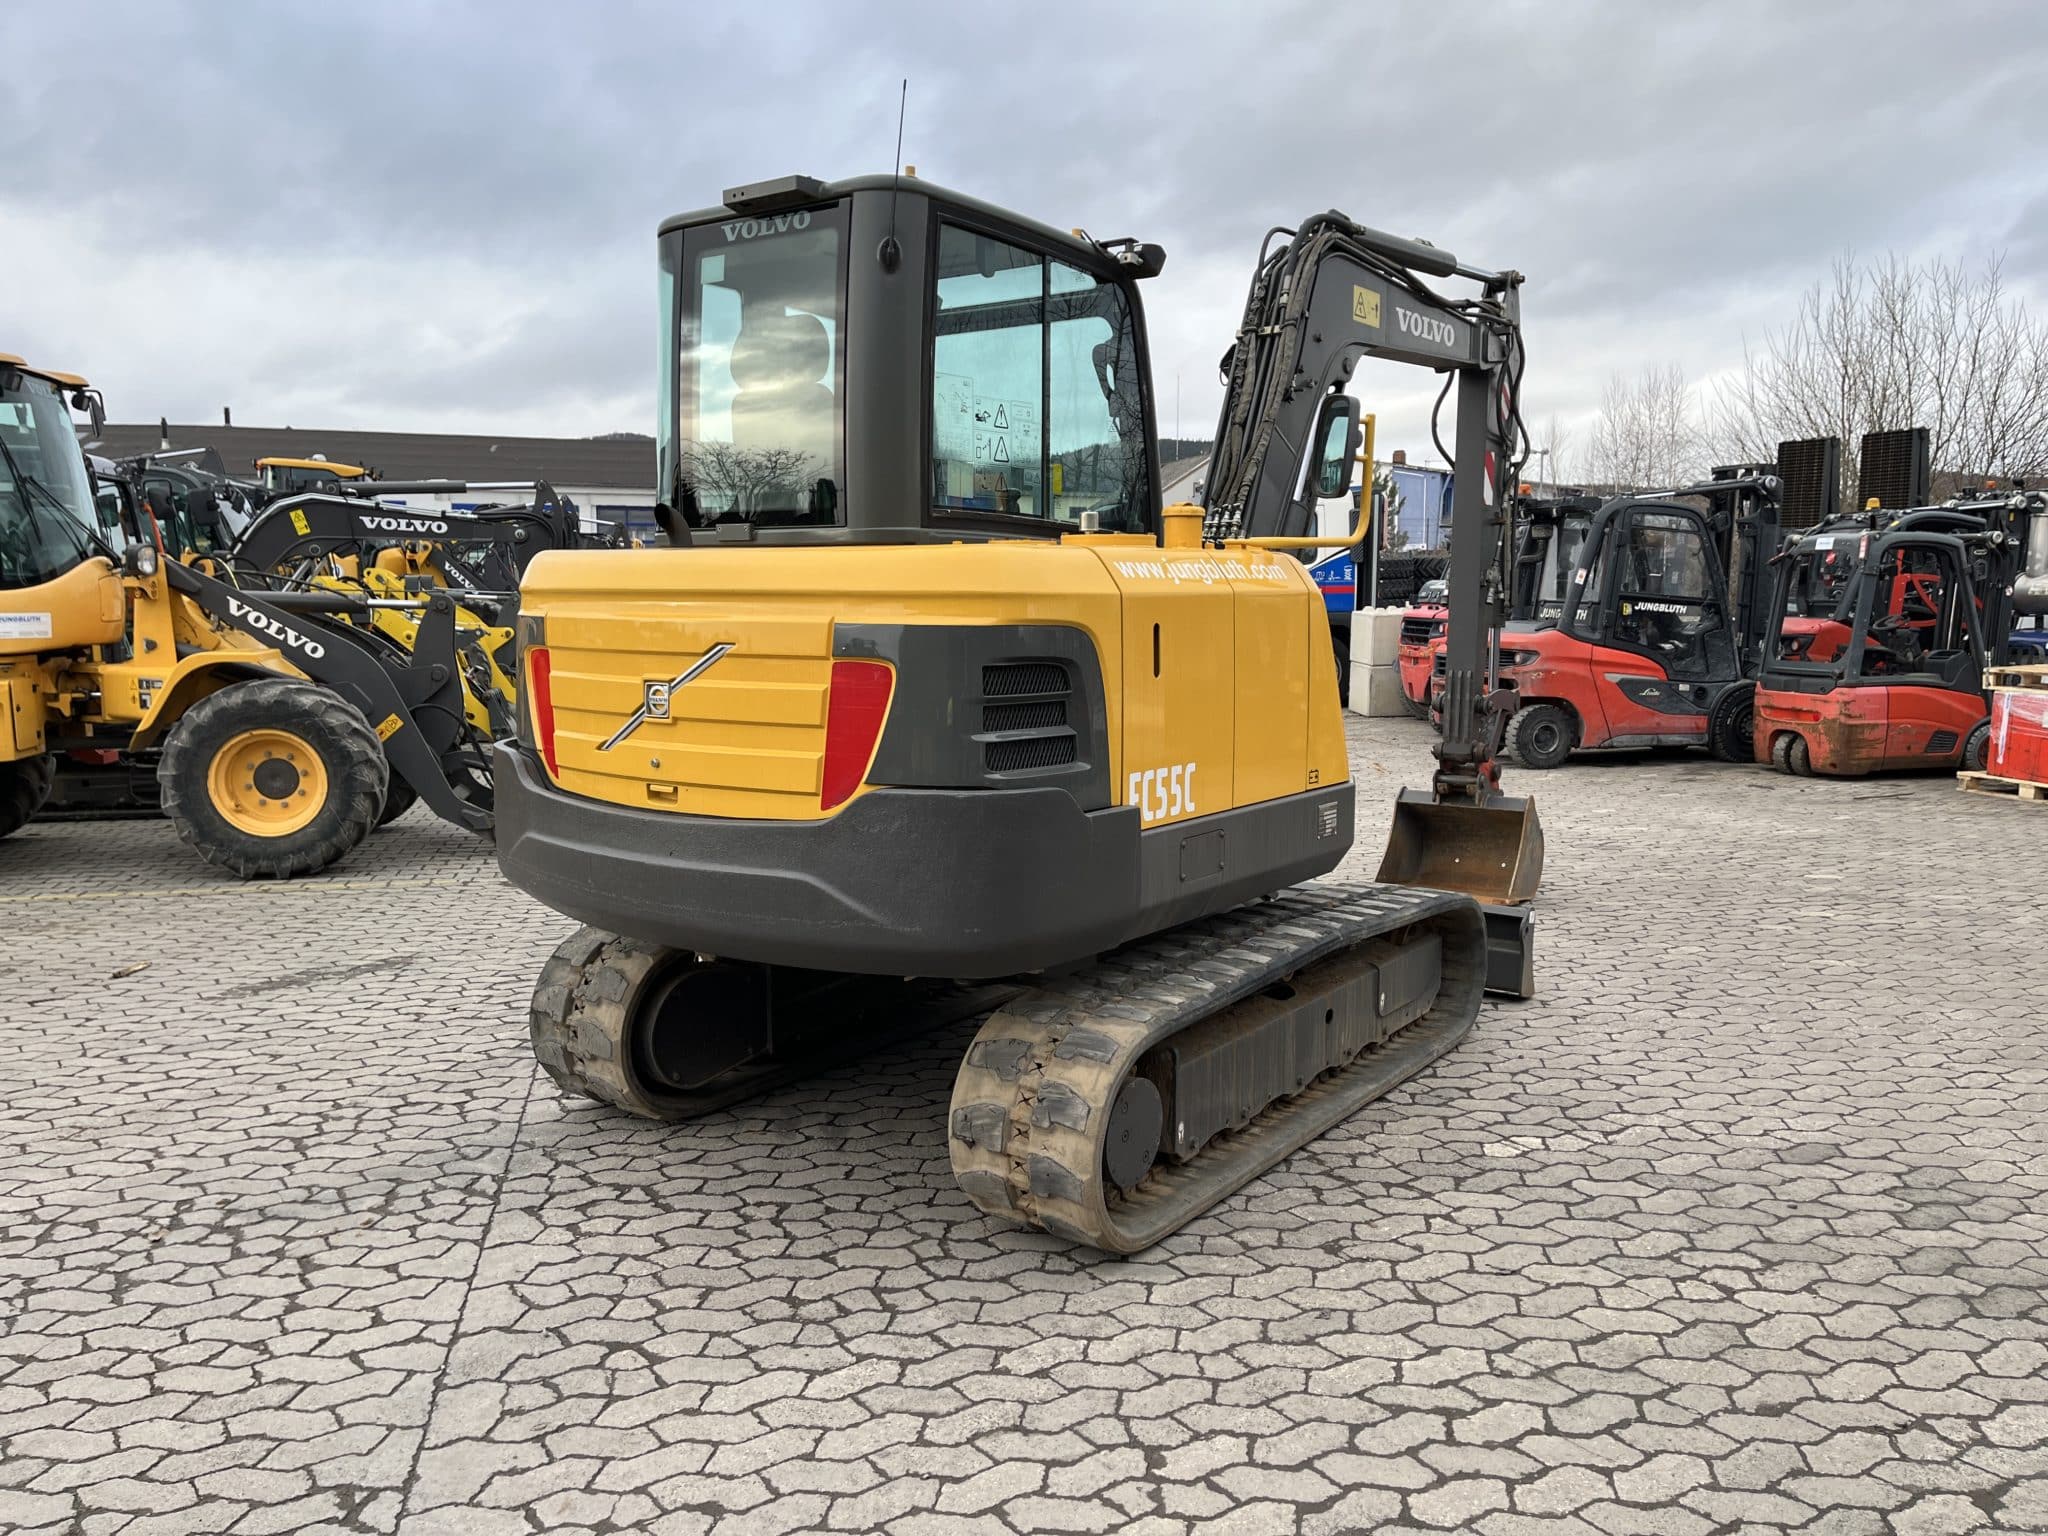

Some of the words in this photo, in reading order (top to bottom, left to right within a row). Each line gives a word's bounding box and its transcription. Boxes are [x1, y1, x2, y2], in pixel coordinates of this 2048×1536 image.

[721, 210, 811, 242] VOLVO
[1395, 306, 1456, 347] VOLVO
[359, 515, 449, 535] VOLVO
[444, 560, 478, 592] VOLV
[1113, 558, 1287, 585] www.jungbluth.com
[1540, 607, 1588, 621] JUNGTH
[1634, 601, 1688, 614] JUNGBLUTH
[226, 595, 326, 659] VOLVO
